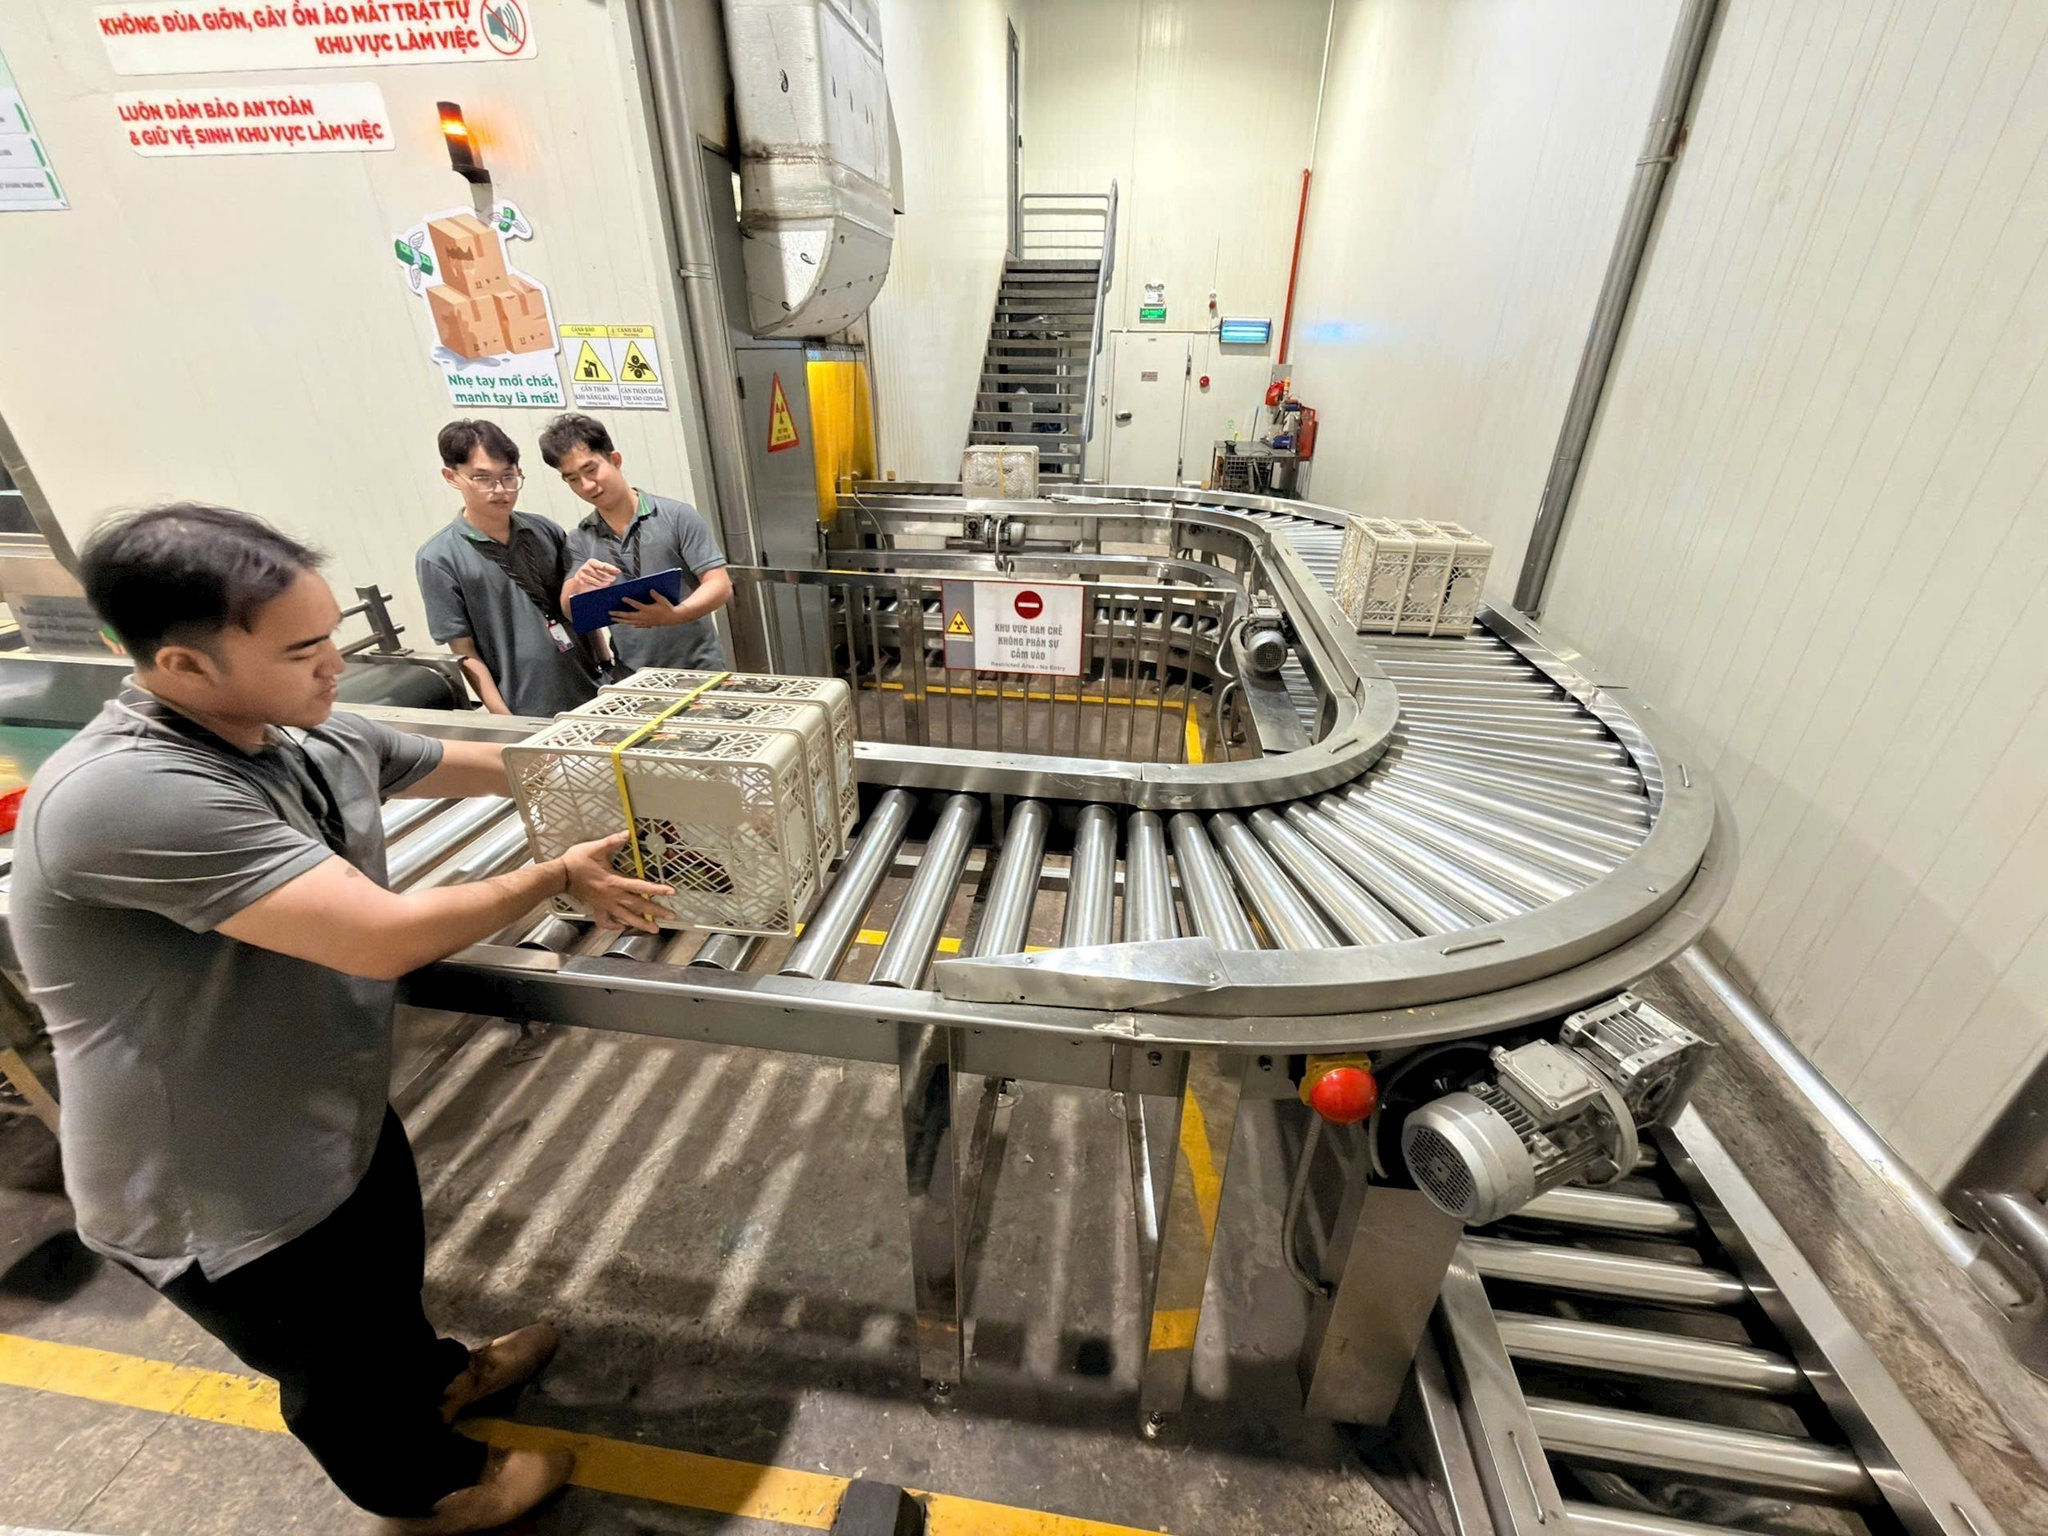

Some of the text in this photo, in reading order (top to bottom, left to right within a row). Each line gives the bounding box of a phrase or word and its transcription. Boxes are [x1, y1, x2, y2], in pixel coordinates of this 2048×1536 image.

[99, 12, 160, 36] KHÔNG
[162, 10, 202, 32] ĐÙA
[315, 25, 480, 58] KHU VỰC LÀM VIỆC
[243, 101, 267, 118] AN
[266, 96, 314, 116] TOÀN
[130, 130, 140, 146] &
[170, 124, 195, 150] VỆ
[195, 128, 234, 144] SINH
[235, 126, 269, 143] KHU
[270, 125, 306, 147] VỰC
[308, 120, 344, 140] LÀM
[344, 119, 384, 144] VIỆC
[448, 374, 473, 388] Nhẹ
[476, 376, 496, 388] tay
[526, 374, 558, 388] chất,
[455, 391, 560, 406] mạnh tay là mất!
[994, 624, 1010, 632] KHU
[998, 636, 1024, 646] KHÔNG
